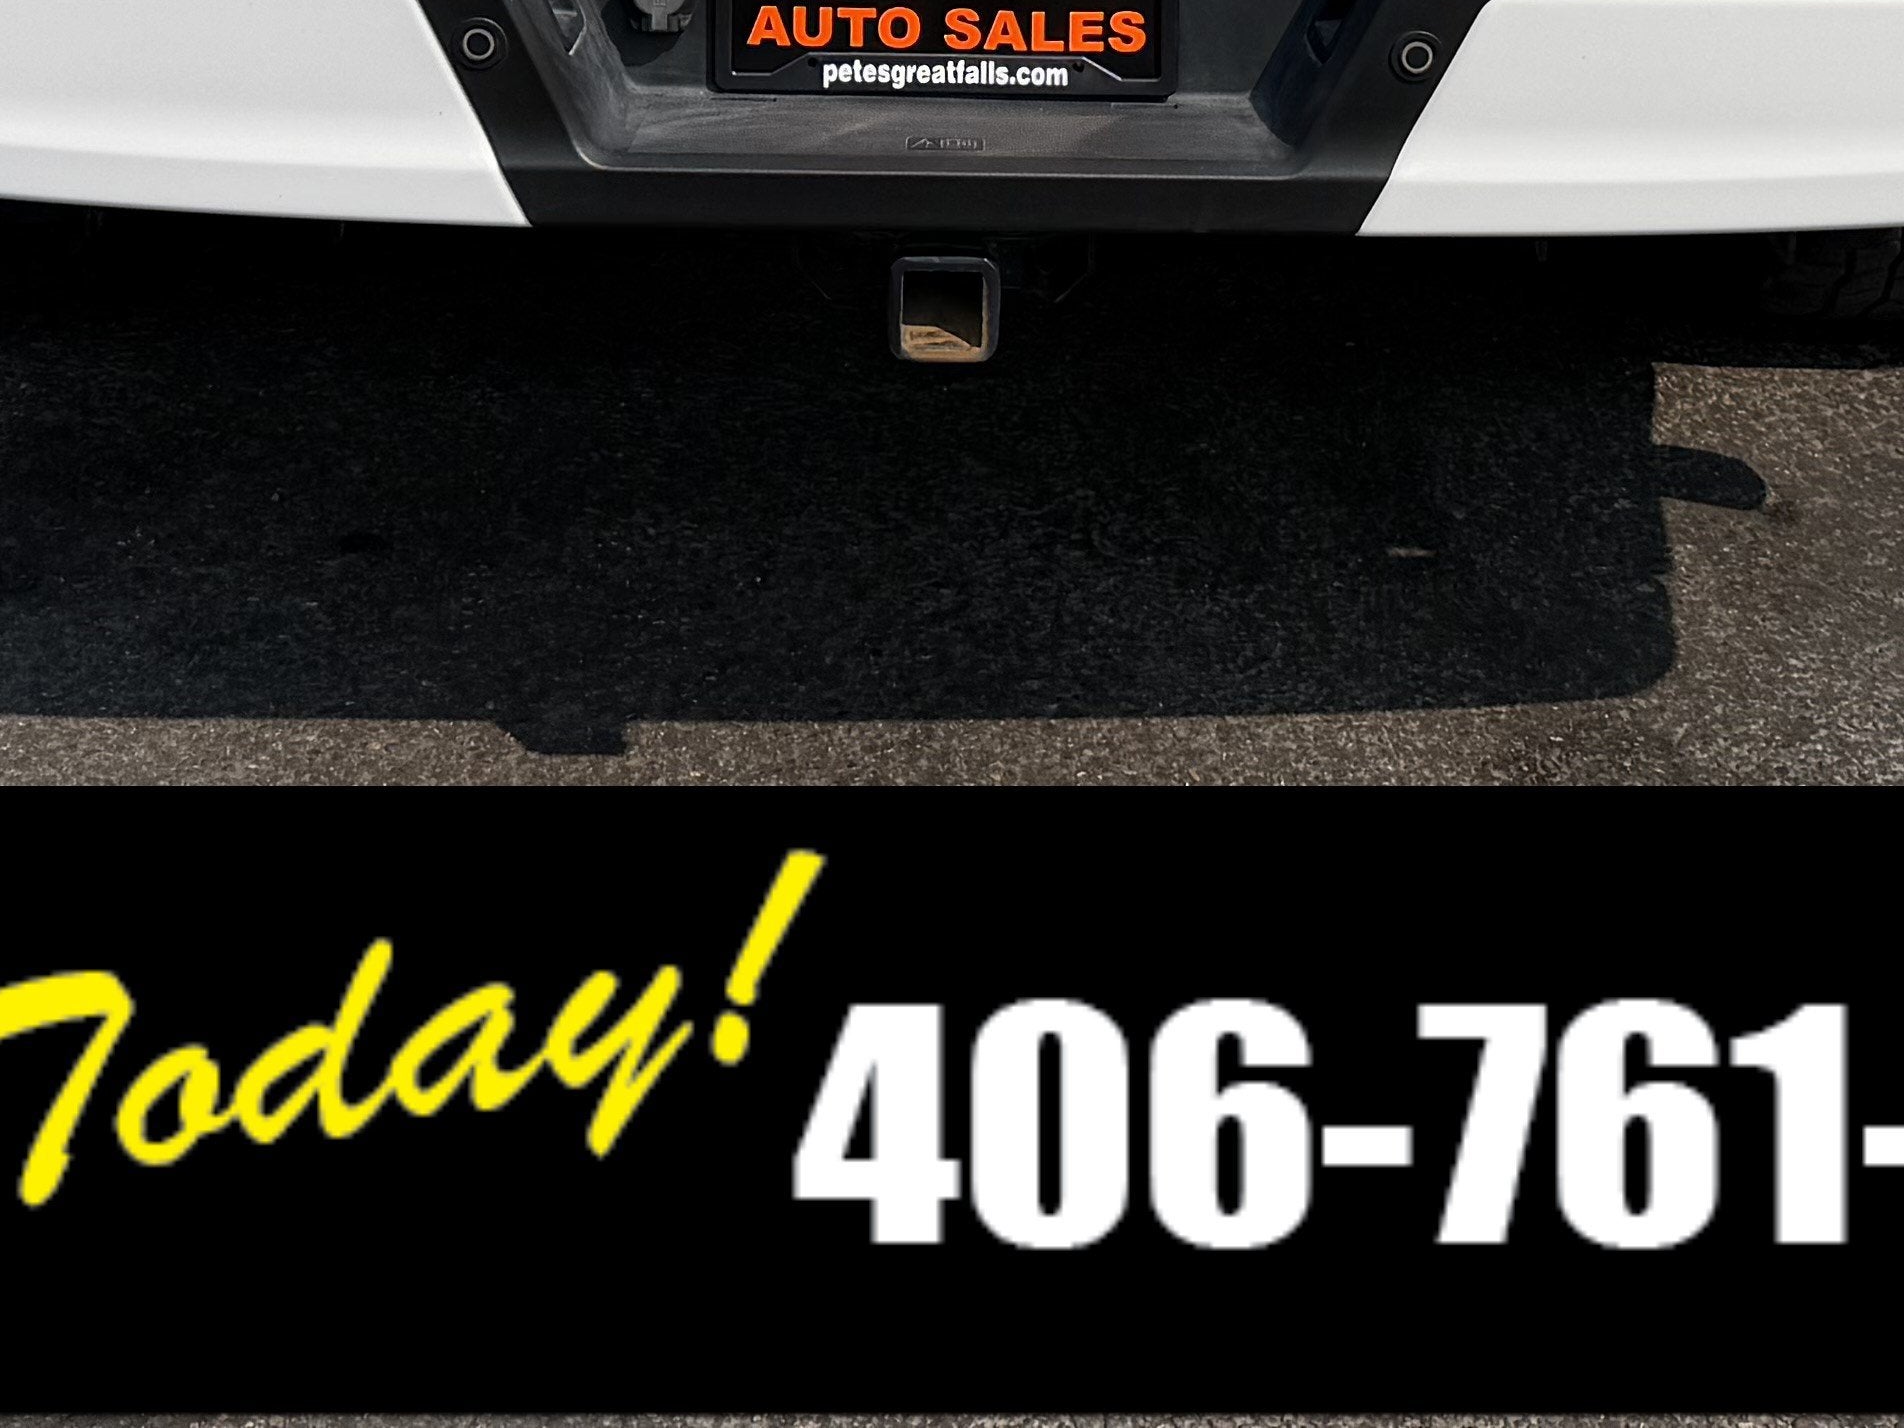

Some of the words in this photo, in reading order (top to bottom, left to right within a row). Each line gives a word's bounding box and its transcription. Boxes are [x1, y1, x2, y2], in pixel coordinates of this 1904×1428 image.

[746, 5, 921, 49] AUTO
[944, 7, 1147, 53] SALES
[822, 58, 1069, 90] petesgreatfalls.com
